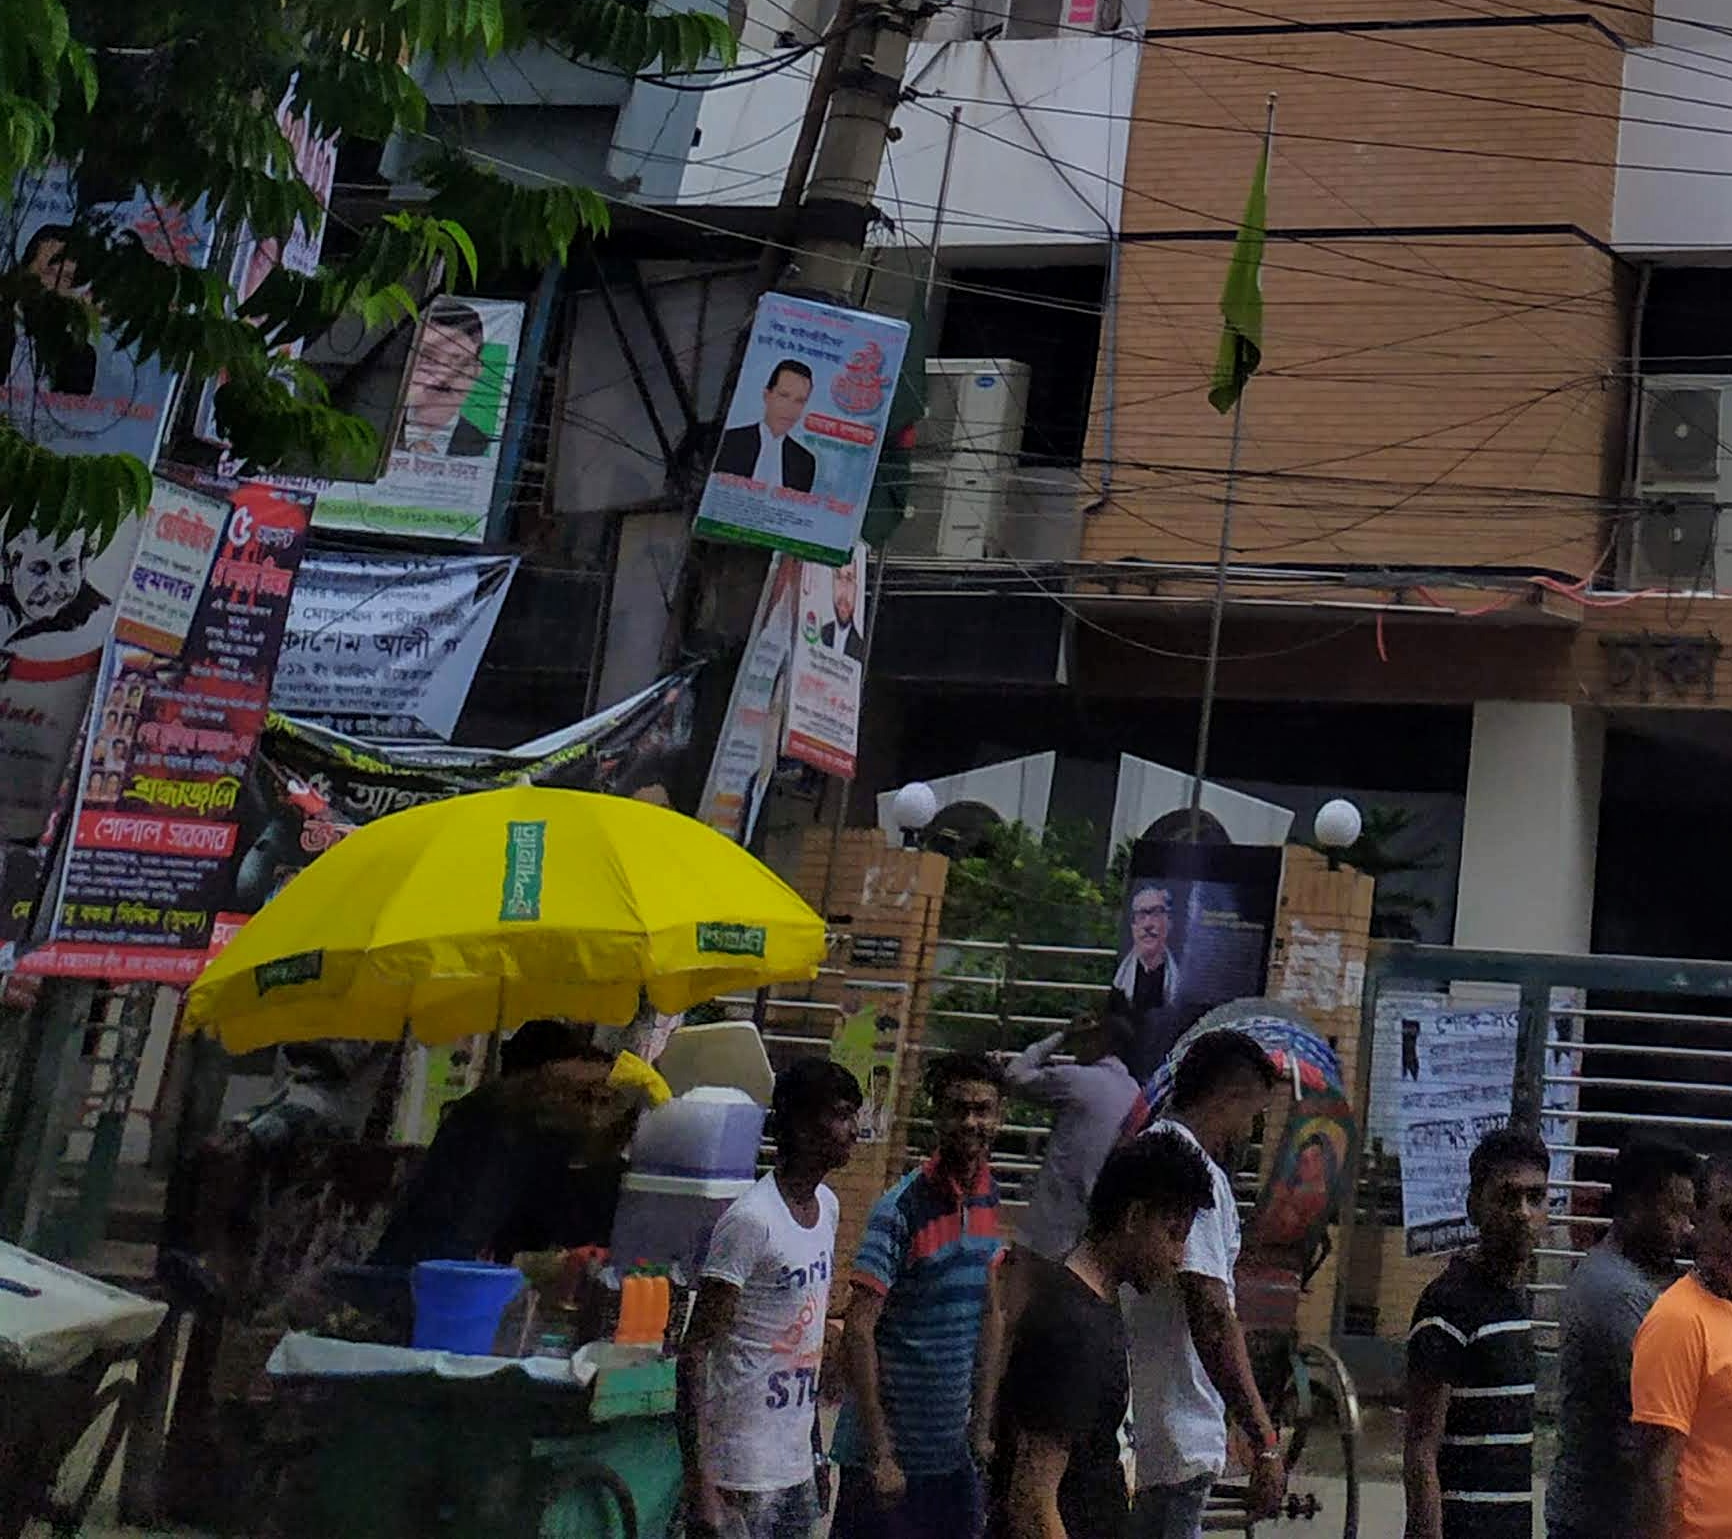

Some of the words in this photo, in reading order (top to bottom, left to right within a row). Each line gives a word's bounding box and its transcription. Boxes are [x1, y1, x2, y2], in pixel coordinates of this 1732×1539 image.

[373, 626, 436, 659] আলী
[95, 815, 161, 845] গোপাল
[168, 823, 230, 851] সরকার
